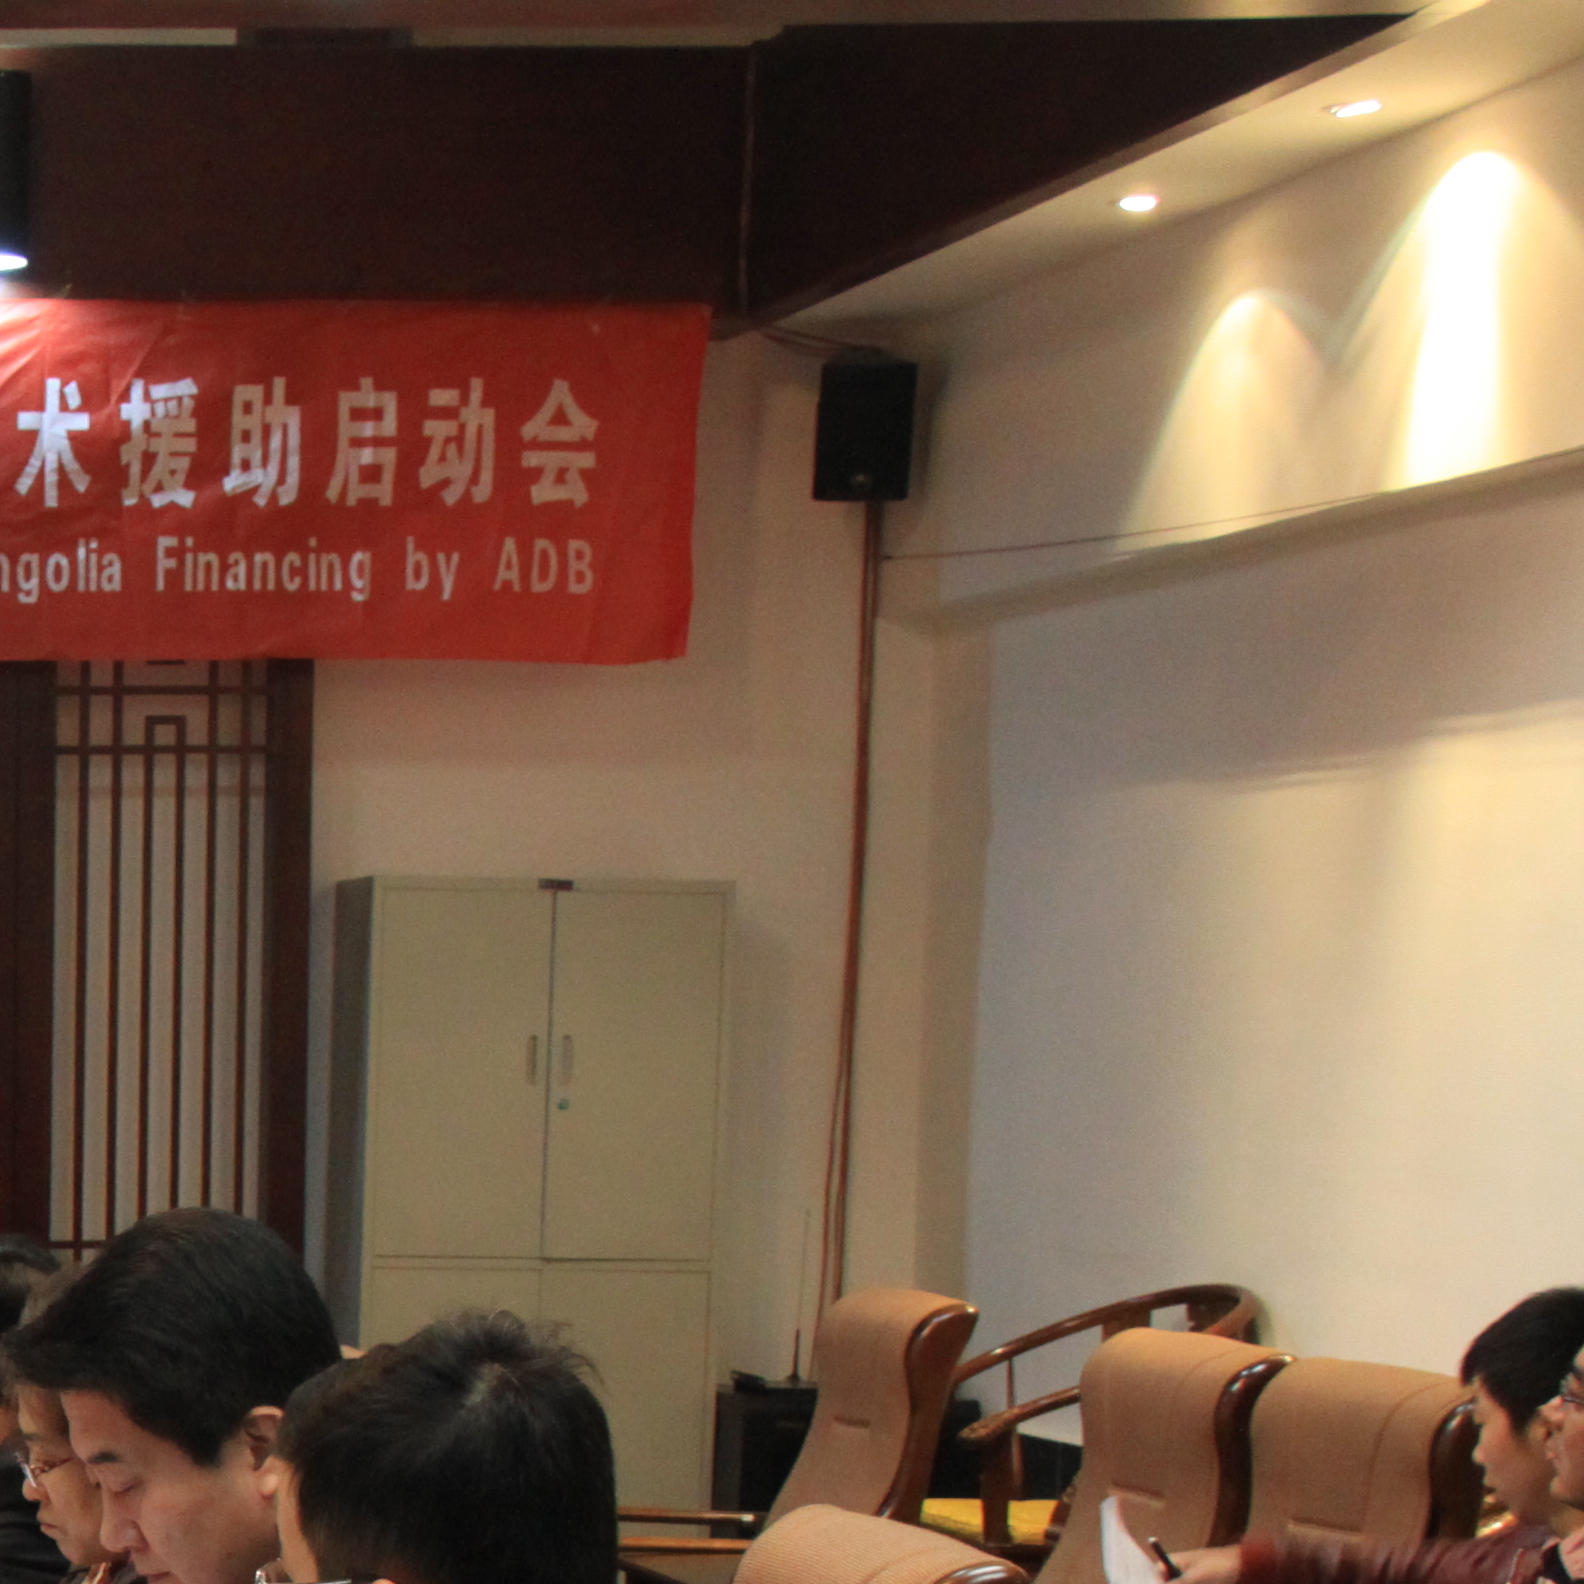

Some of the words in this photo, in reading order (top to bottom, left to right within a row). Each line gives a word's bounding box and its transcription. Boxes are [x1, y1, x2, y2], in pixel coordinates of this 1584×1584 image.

[154, 535, 371, 604] Financing
[405, 536, 460, 602] by
[494, 537, 595, 594] ADB
